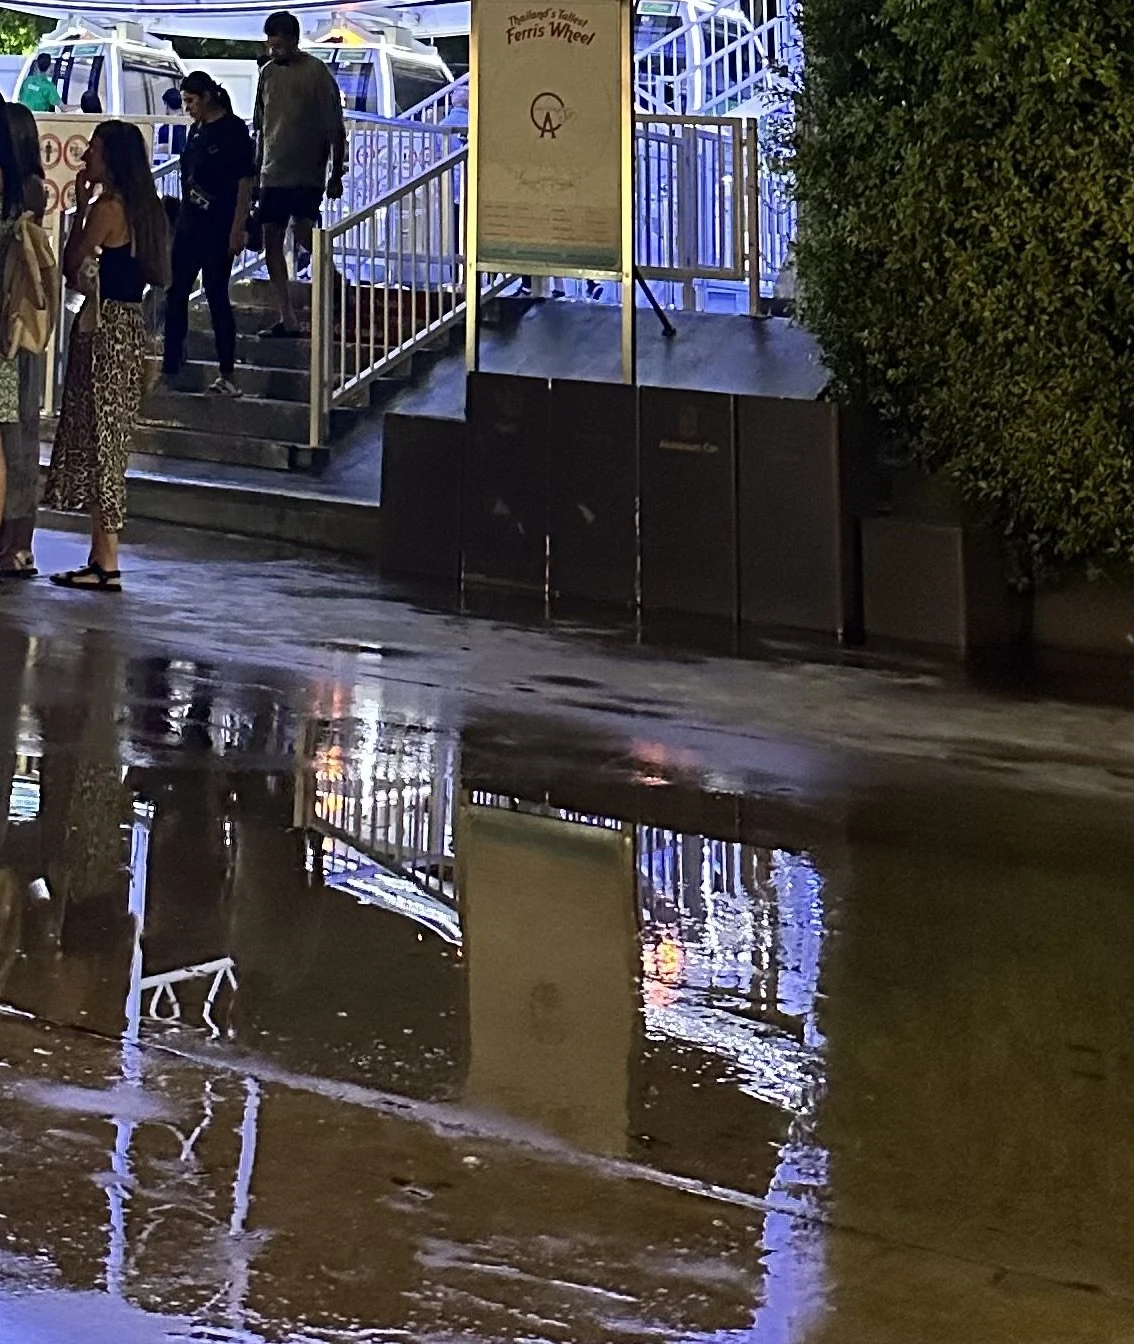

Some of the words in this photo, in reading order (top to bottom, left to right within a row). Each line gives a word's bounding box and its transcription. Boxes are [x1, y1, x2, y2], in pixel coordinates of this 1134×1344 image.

[507, 7, 556, 27] Thailand's
[558, 8, 588, 28] Tallest
[506, 23, 545, 45] Ferris
[548, 21, 596, 45] Wheel
